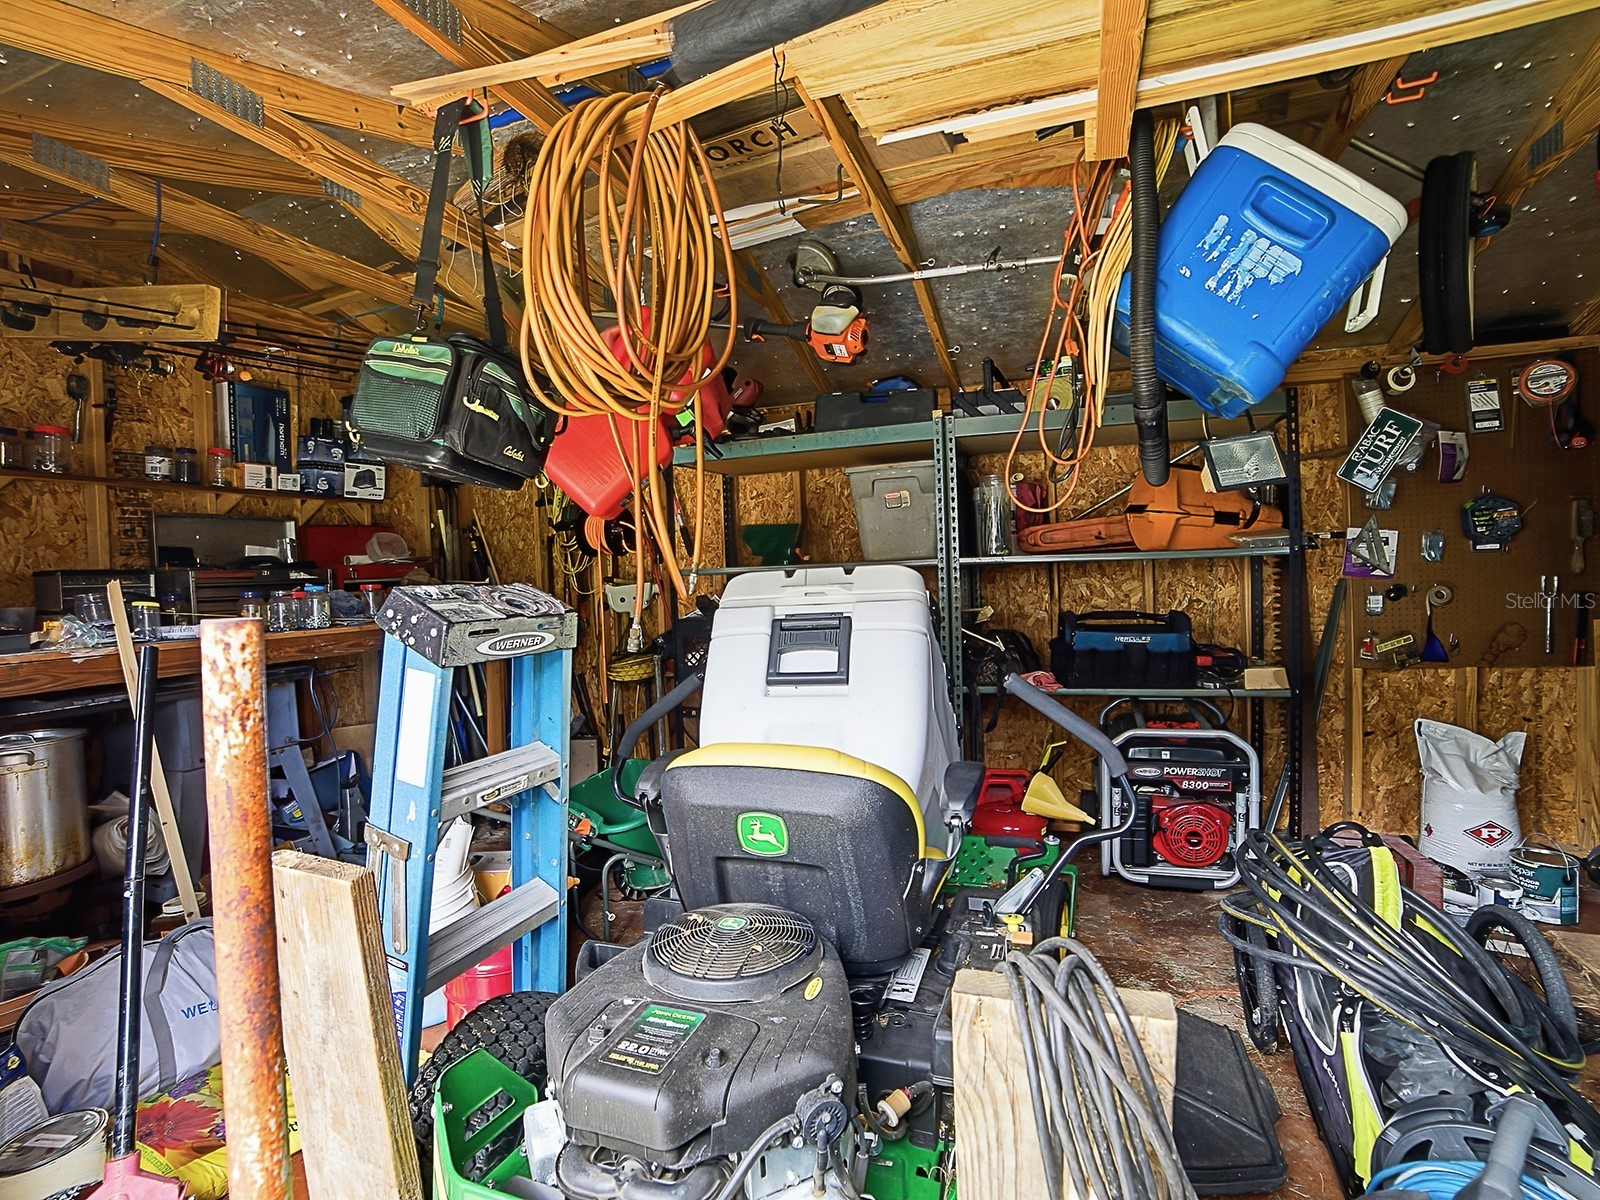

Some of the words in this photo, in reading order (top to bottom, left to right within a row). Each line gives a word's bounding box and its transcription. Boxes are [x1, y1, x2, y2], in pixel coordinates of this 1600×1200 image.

[692, 119, 799, 162] ORCH
[1353, 419, 1403, 477] TURF
[1359, 425, 1381, 456] ABAC
[495, 636, 543, 651] WERNER
[1163, 766, 1227, 778] POWERSHOT
[1181, 780, 1210, 790] 8300
